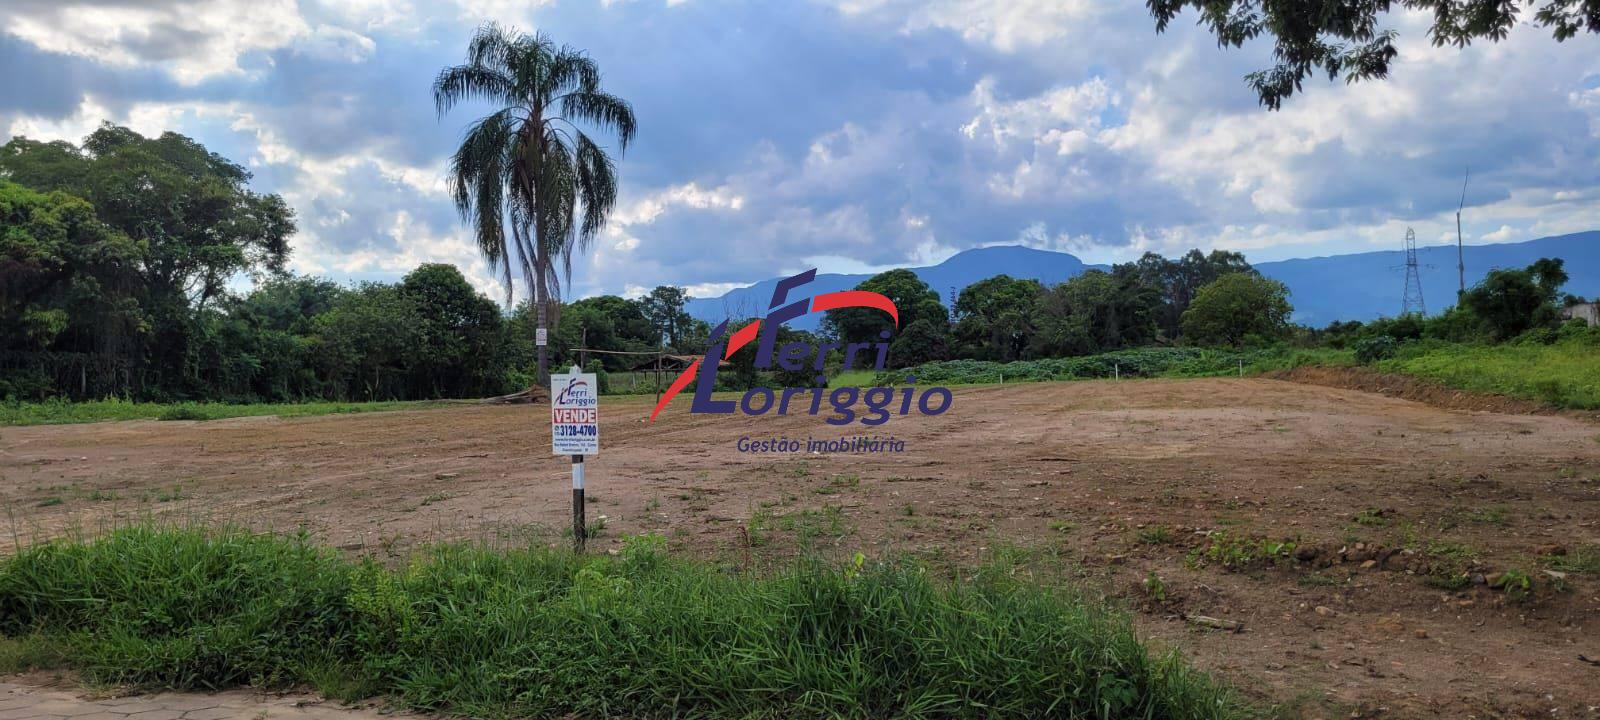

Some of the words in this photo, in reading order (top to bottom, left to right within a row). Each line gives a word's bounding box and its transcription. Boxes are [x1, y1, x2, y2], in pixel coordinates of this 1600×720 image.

[567, 378, 588, 397] Ferri
[559, 389, 597, 406] Loriggio
[554, 409, 596, 423] VENDE
[560, 424, 597, 437] 3128-4700
